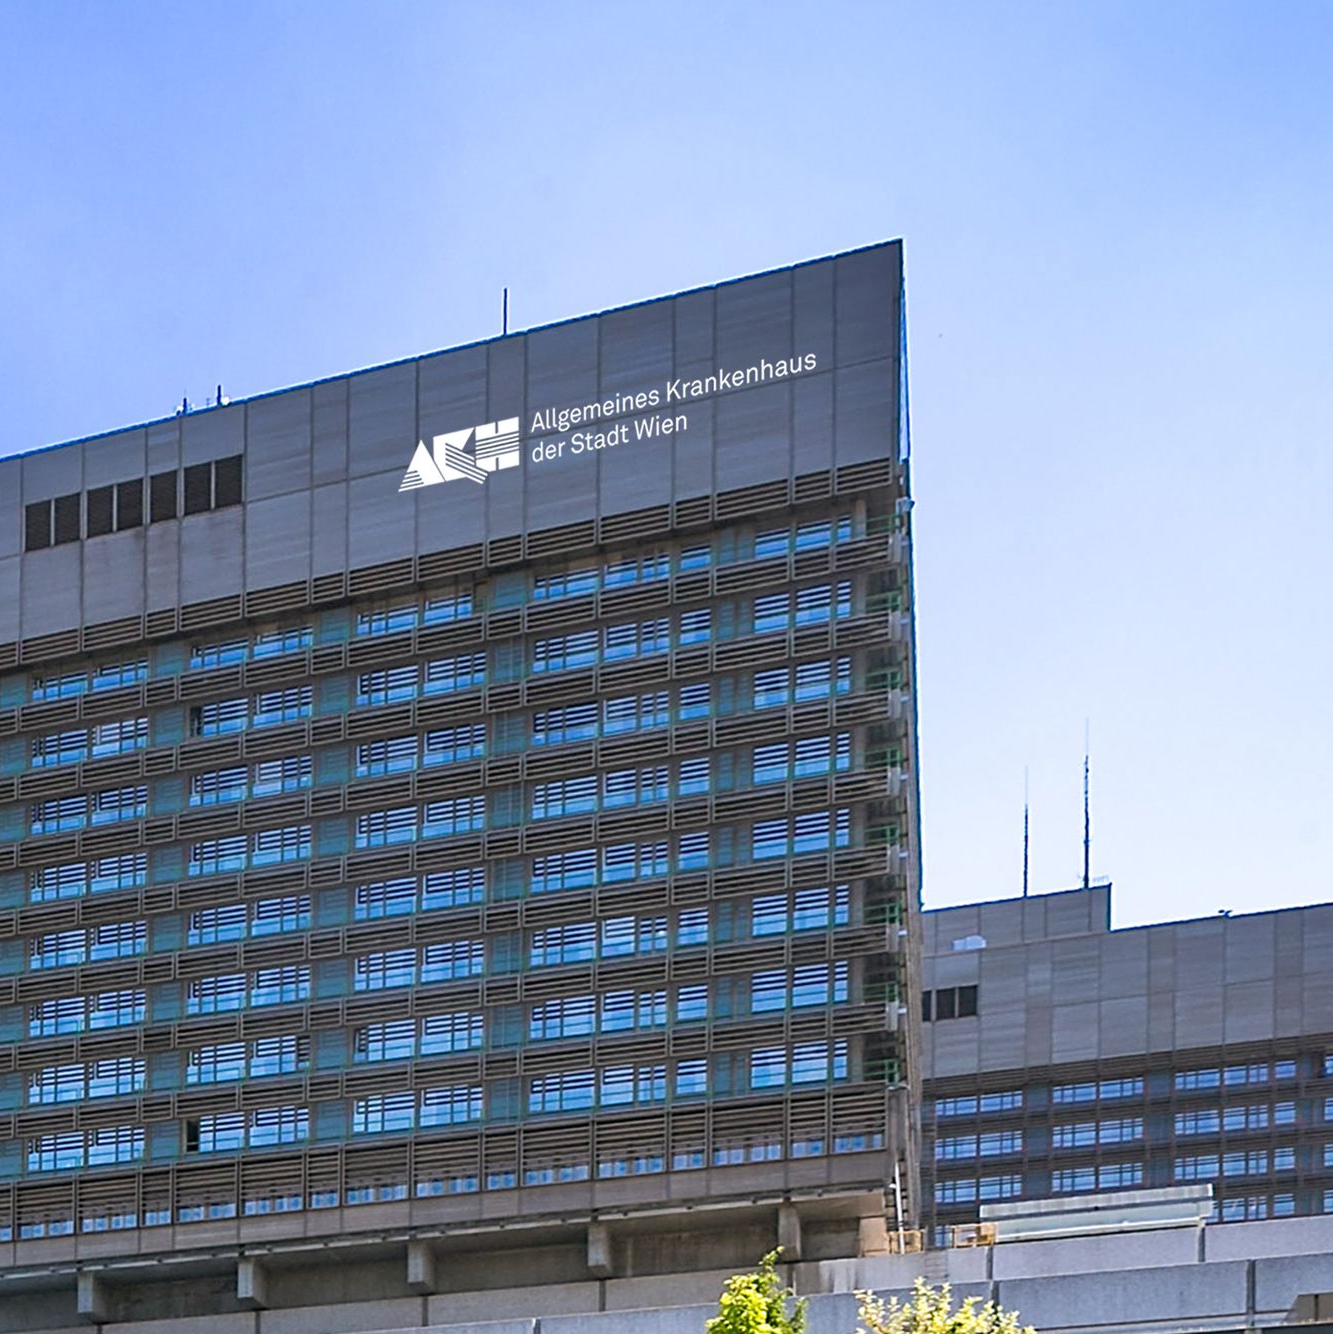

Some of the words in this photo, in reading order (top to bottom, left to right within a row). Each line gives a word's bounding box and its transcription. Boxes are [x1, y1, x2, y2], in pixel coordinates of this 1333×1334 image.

[530, 389, 660, 432] Allgemeines
[666, 353, 817, 403] Krankenhaus
[531, 440, 566, 463] der
[570, 424, 630, 454] Stadt
[634, 415, 687, 440] Wien
